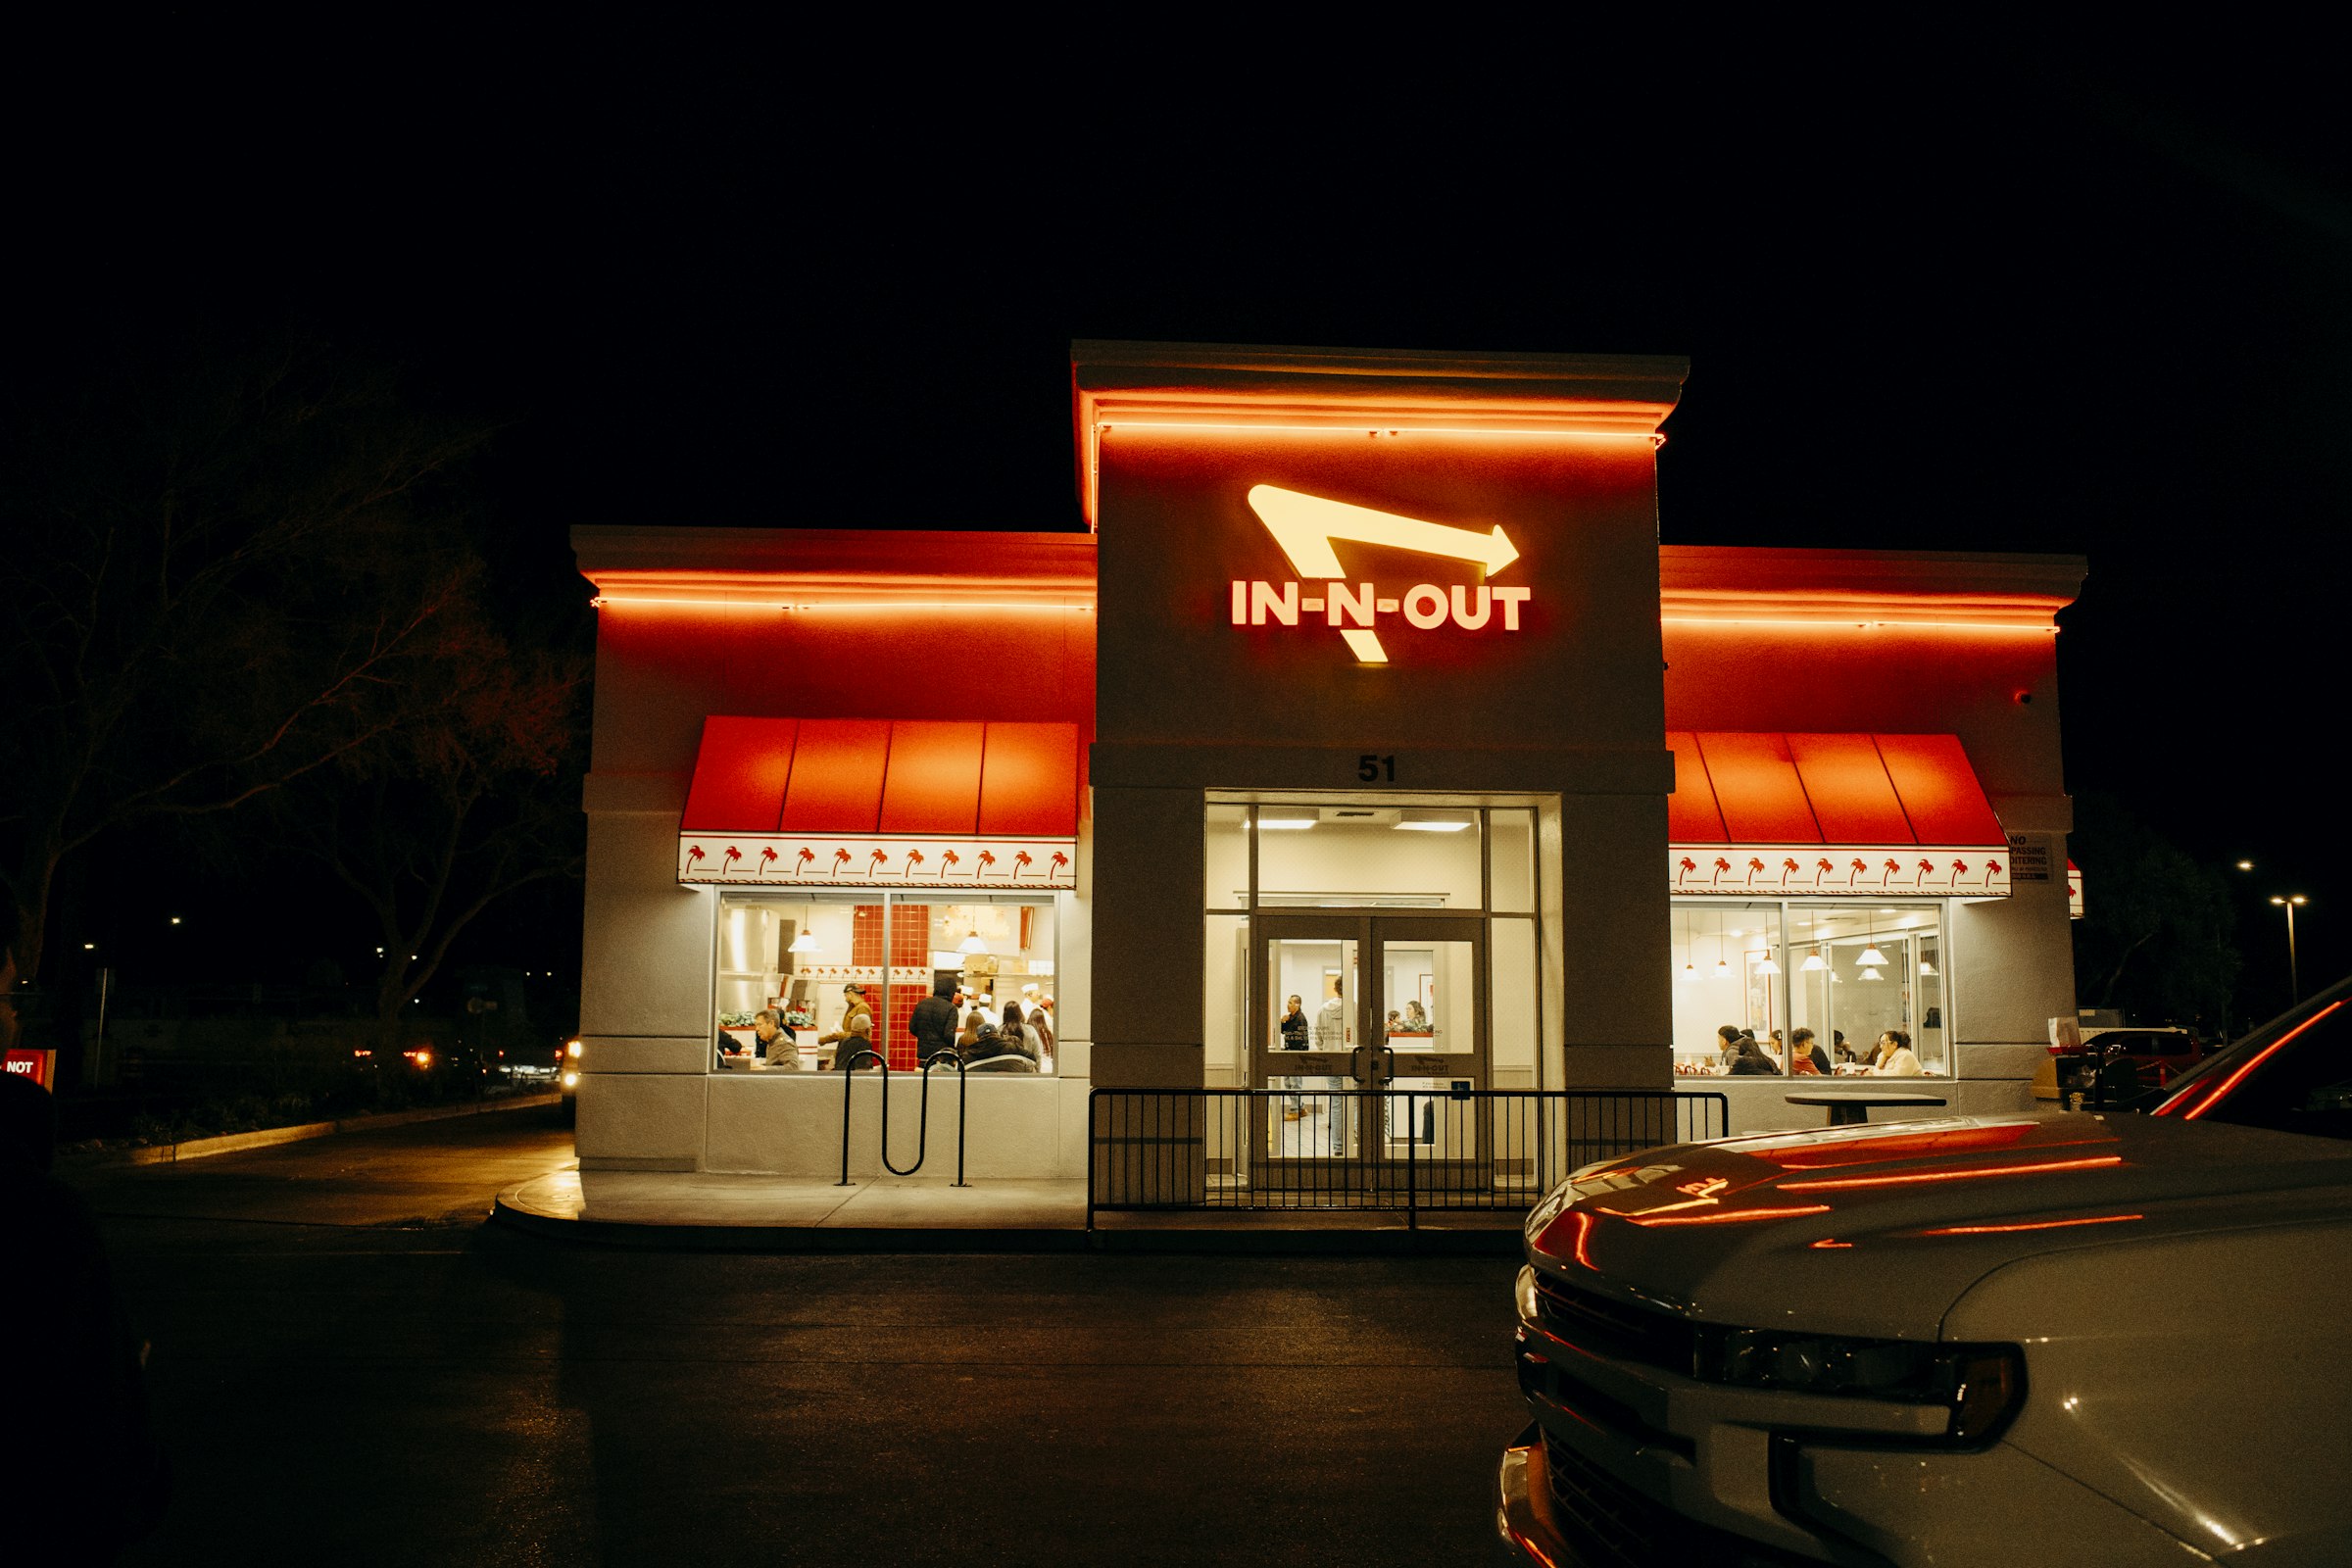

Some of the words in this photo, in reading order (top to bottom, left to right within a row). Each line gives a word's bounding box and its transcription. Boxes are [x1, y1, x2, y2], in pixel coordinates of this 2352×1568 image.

[1232, 580, 1531, 630] IN-N-OUT
[1359, 755, 1394, 782] 51
[2010, 836, 2027, 845] NO
[7, 1061, 33, 1073] NOT
